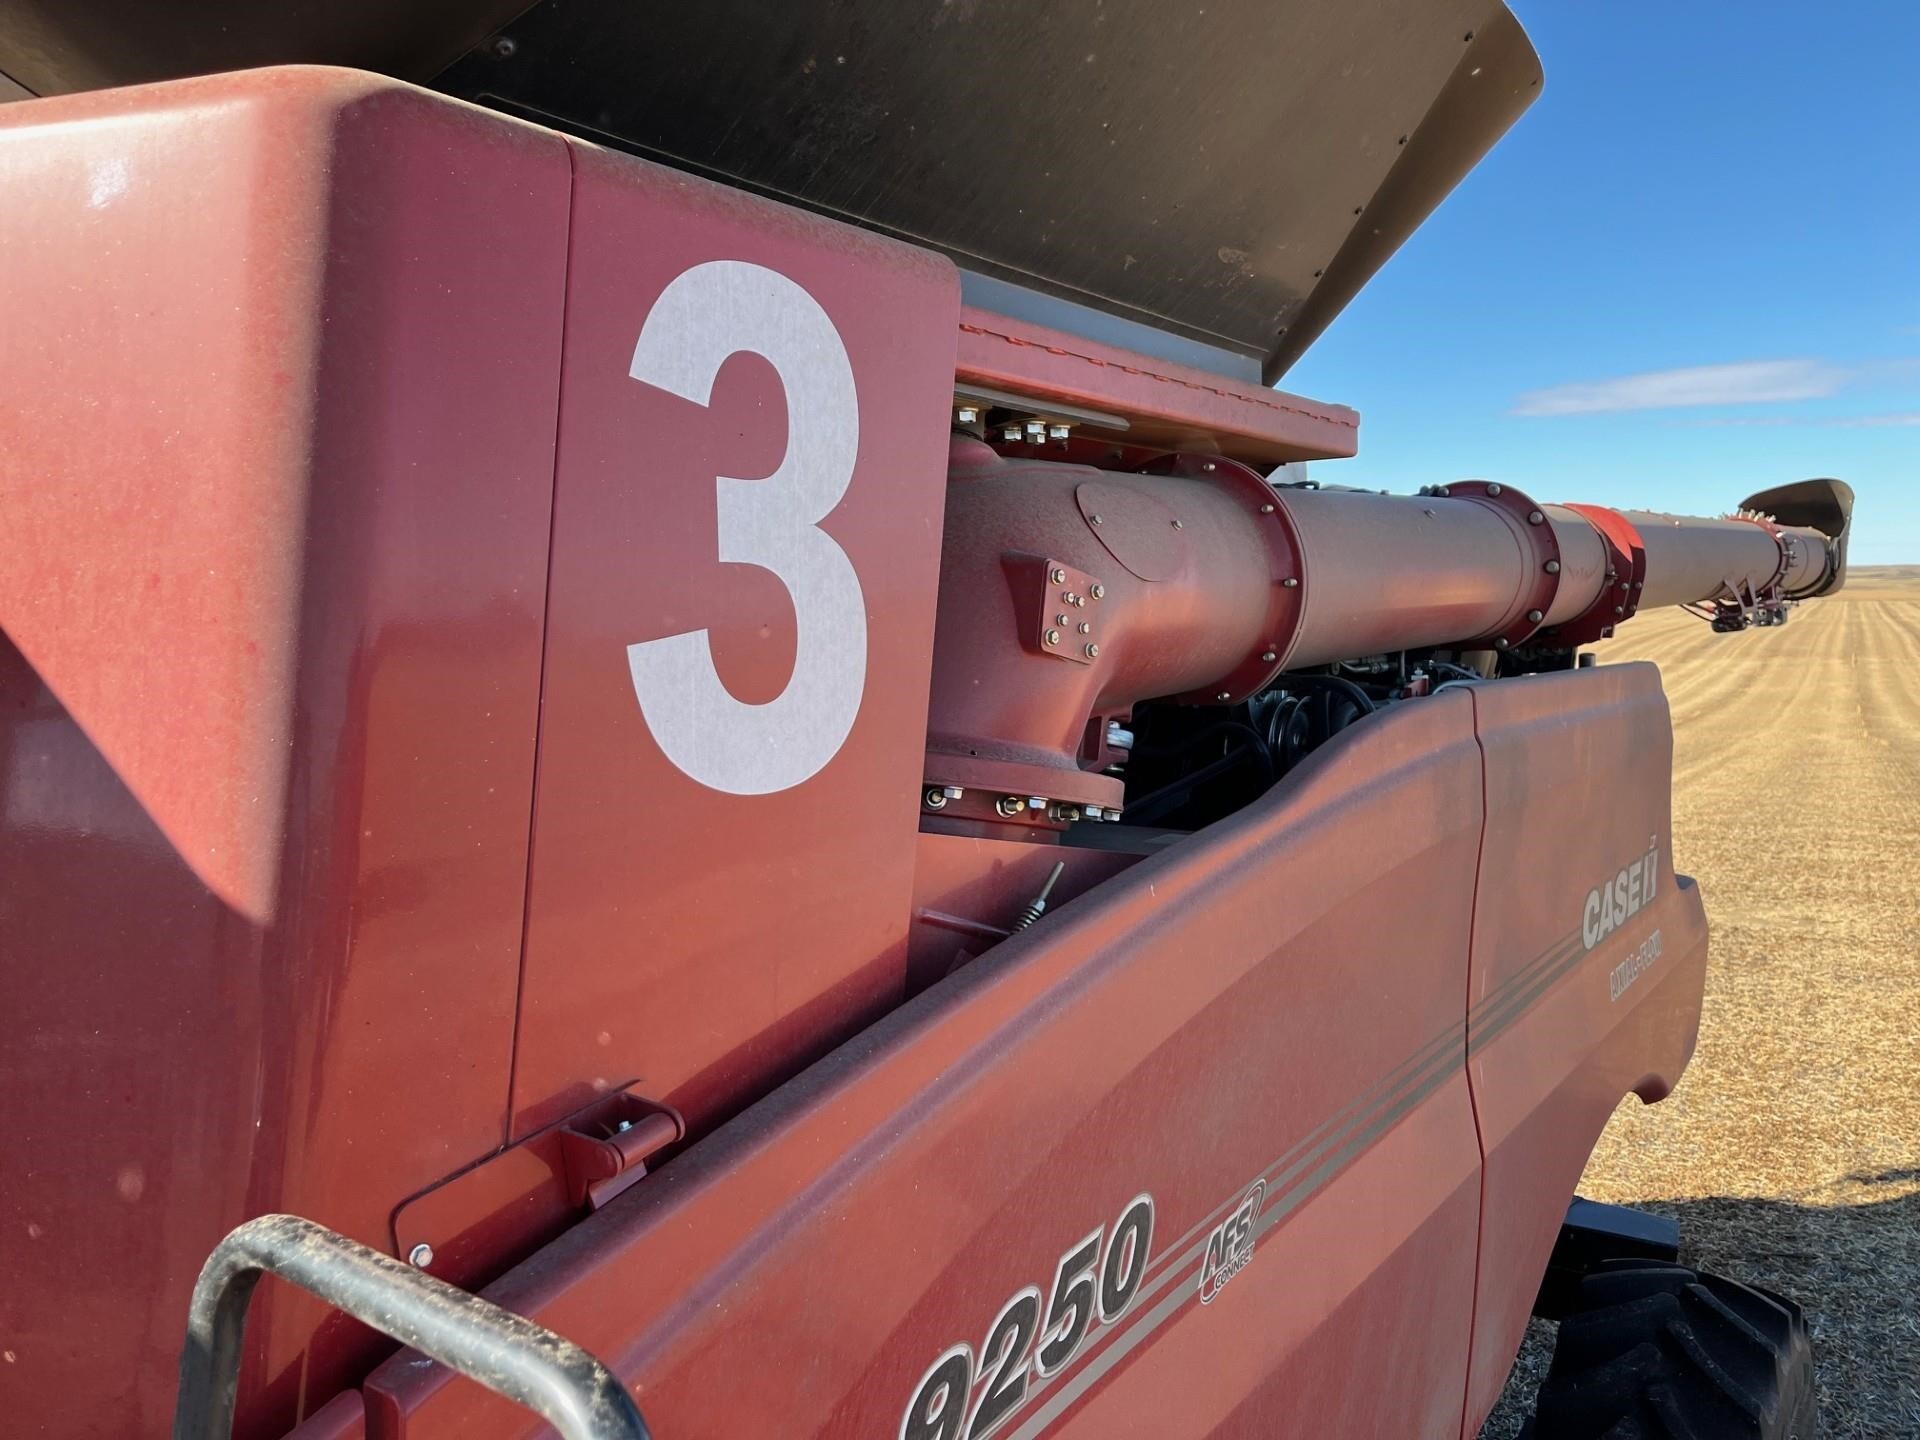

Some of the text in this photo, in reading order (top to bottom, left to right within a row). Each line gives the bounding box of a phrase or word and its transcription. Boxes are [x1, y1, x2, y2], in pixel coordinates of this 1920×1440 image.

[627, 260, 867, 795] 3
[1582, 858, 1642, 950] CASE
[1198, 1196, 1255, 1289] AFS
[1215, 1240, 1256, 1290] CONNECT
[898, 1191, 1155, 1440] 9250
